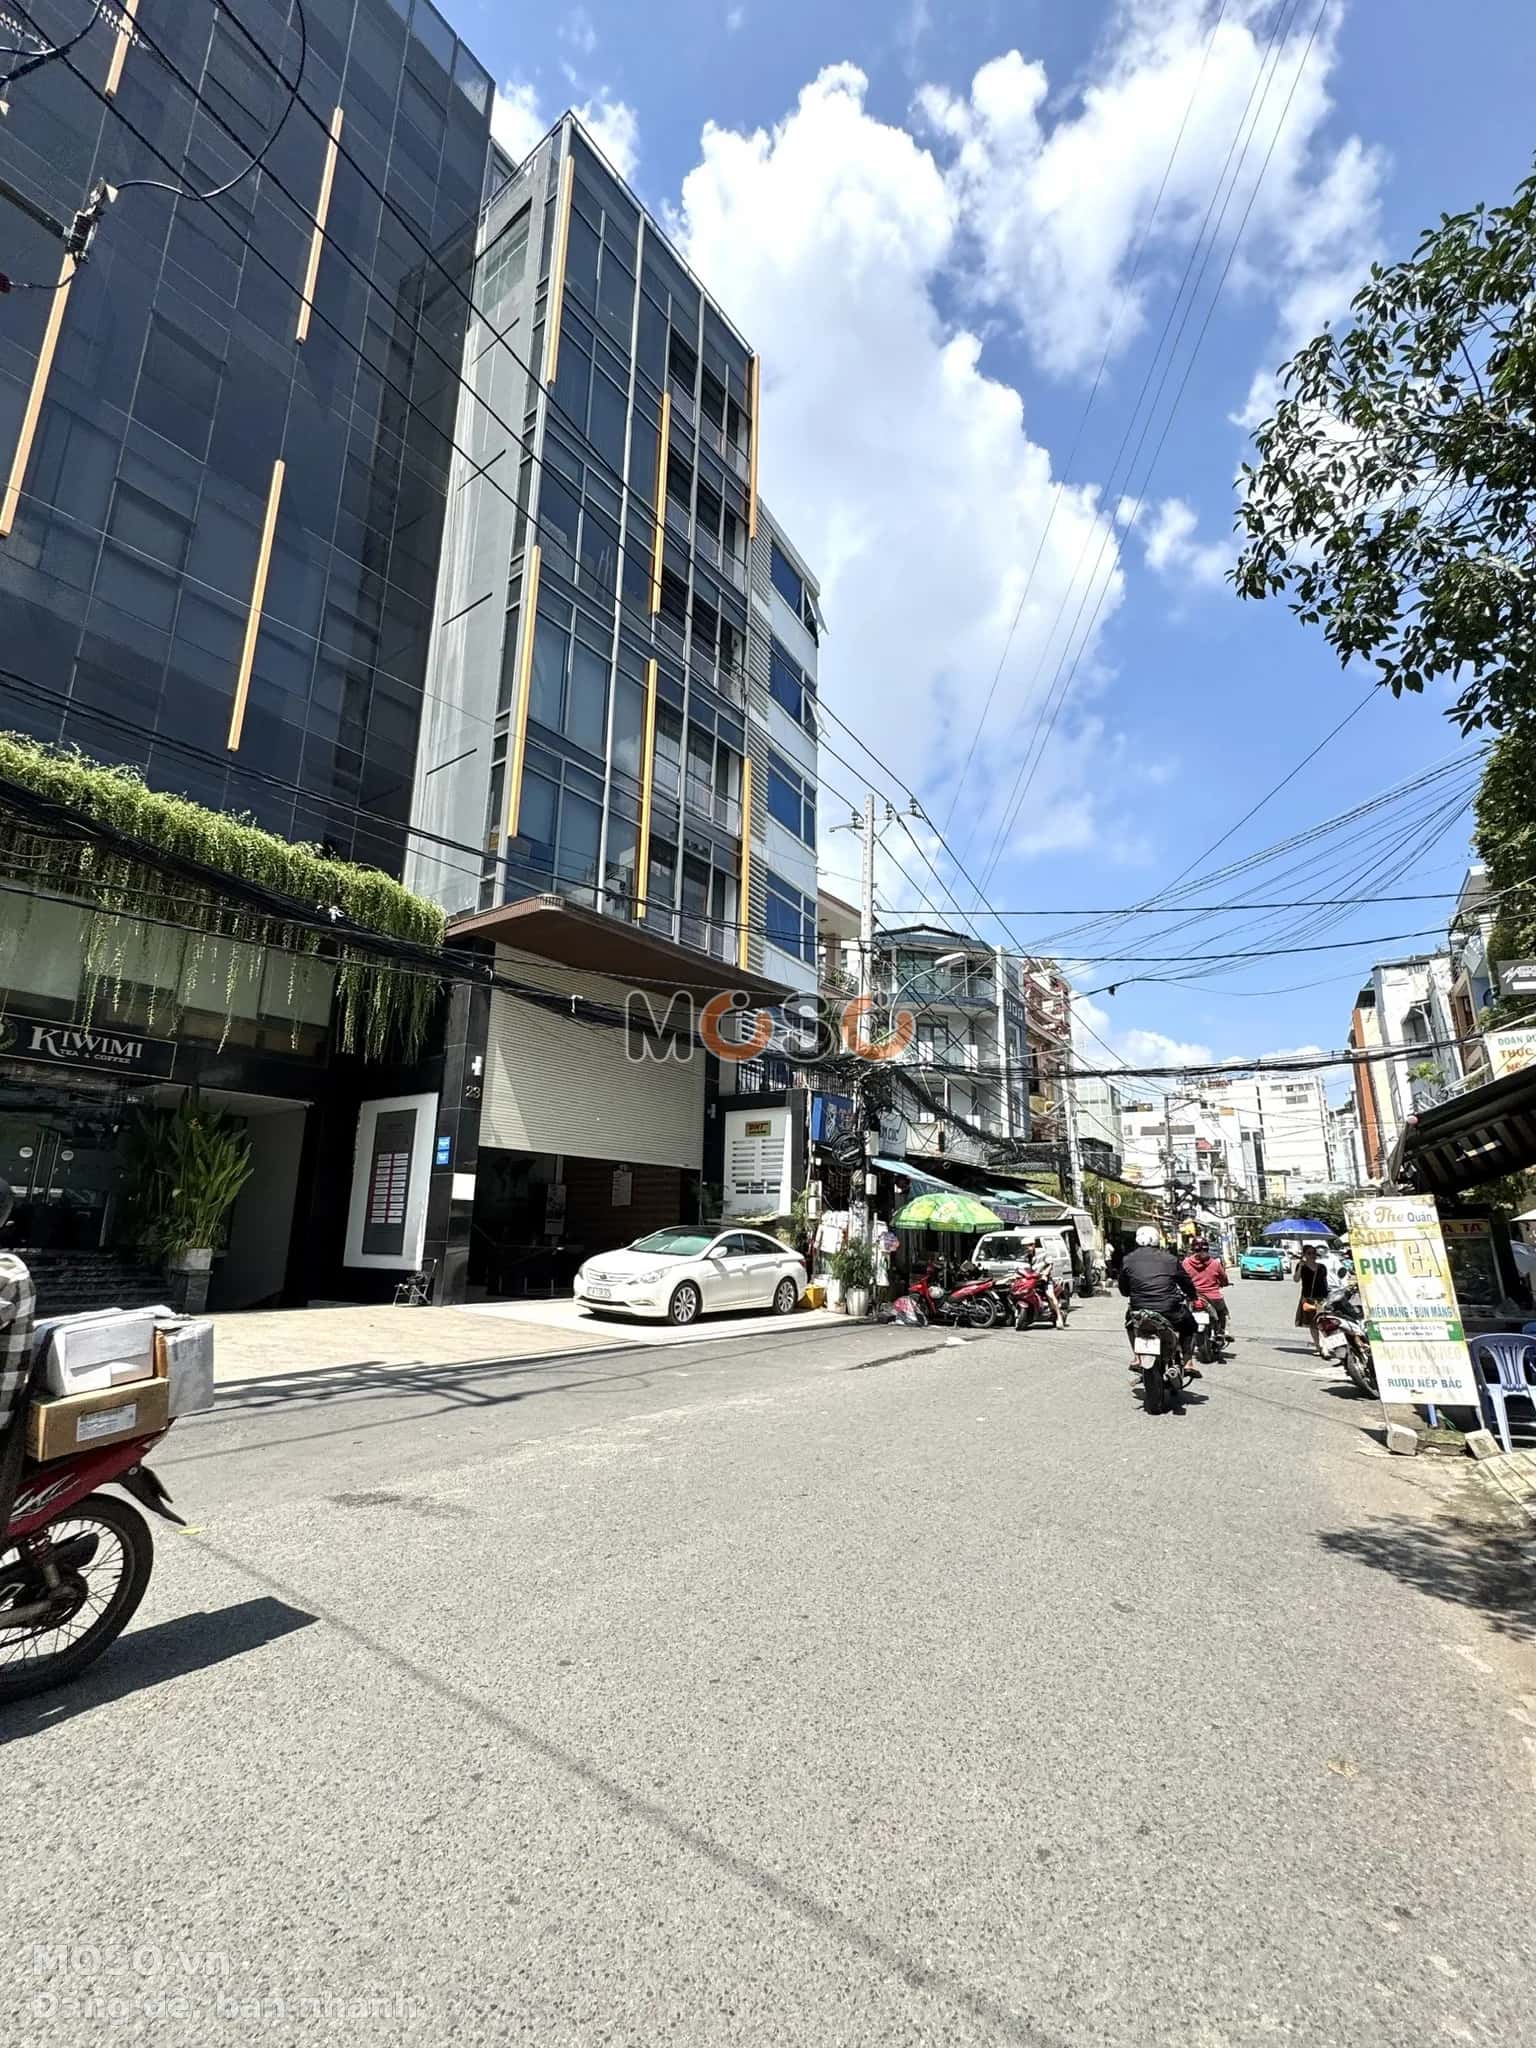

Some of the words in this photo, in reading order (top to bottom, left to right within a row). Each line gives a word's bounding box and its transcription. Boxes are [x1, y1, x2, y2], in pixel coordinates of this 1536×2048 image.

[27, 1026, 143, 1058] KIWIMI
[94, 1055, 131, 1064] COFFEE
[1359, 1252, 1398, 1276] PHỞ
